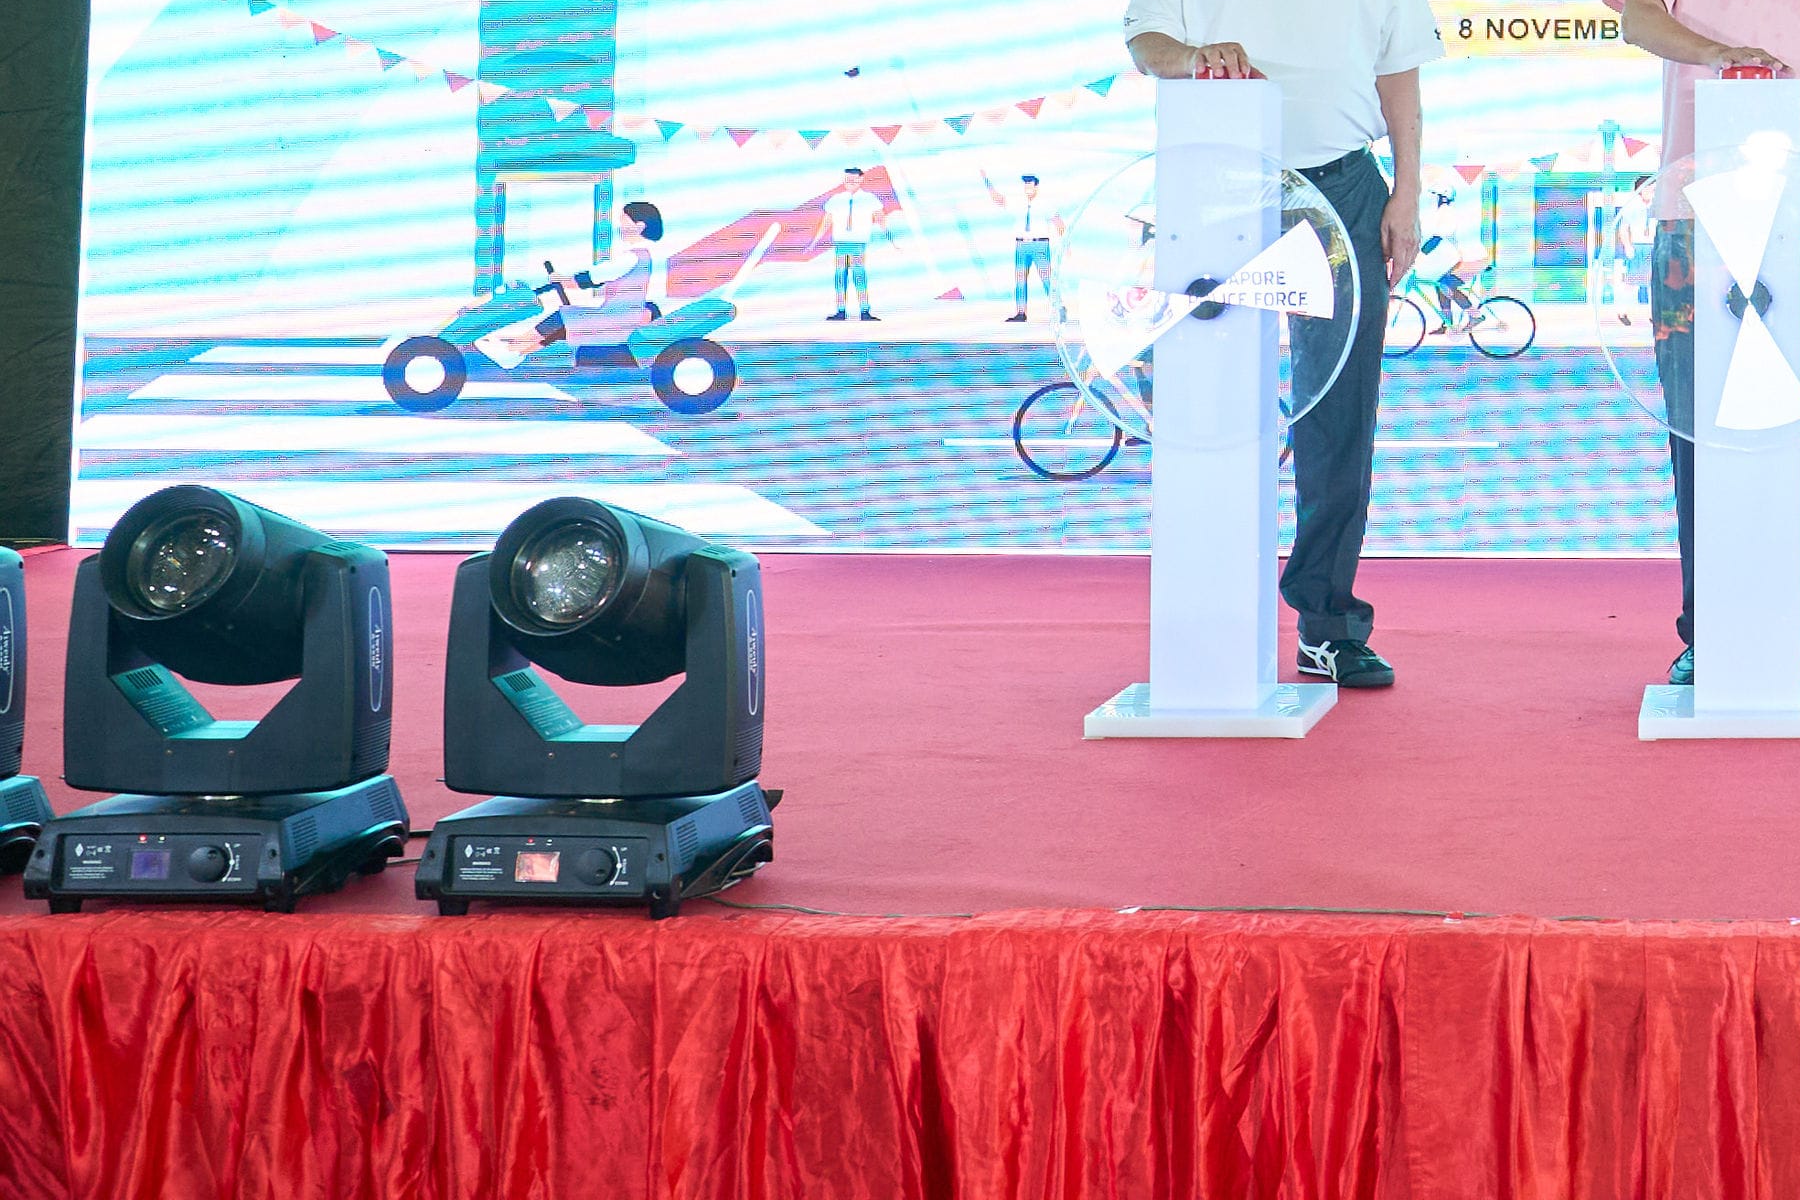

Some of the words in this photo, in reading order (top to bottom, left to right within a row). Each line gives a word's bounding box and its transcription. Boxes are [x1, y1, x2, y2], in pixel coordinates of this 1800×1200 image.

[1459, 18, 1473, 39] 8
[1486, 19, 1619, 39] NOVEMB
[1254, 291, 1308, 306] FORCE
